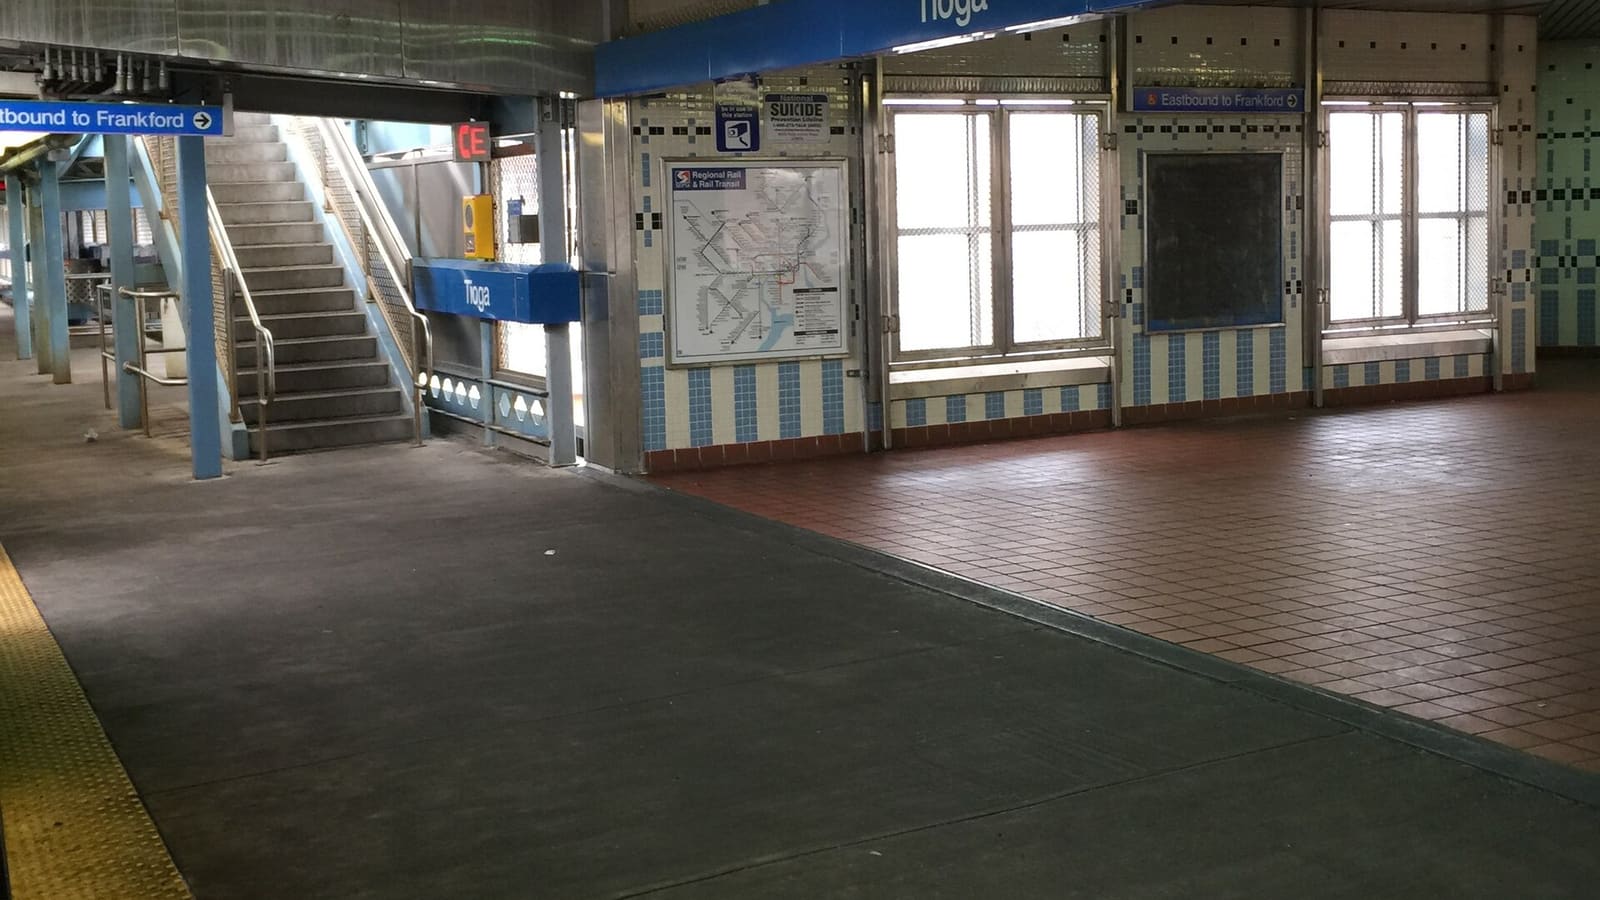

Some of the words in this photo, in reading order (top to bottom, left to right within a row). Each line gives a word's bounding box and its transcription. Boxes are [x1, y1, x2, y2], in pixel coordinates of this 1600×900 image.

[1161, 93, 1219, 106] Eastbound
[1222, 94, 1232, 106] to
[1235, 94, 1284, 106] Frankford
[770, 103, 823, 116] SUICIDE
[0, 108, 65, 125] tbound
[72, 111, 90, 126] to
[97, 110, 184, 128] Frankford
[692, 171, 726, 180] Regional
[727, 171, 742, 179] Rail
[463, 279, 491, 312] Tioga
